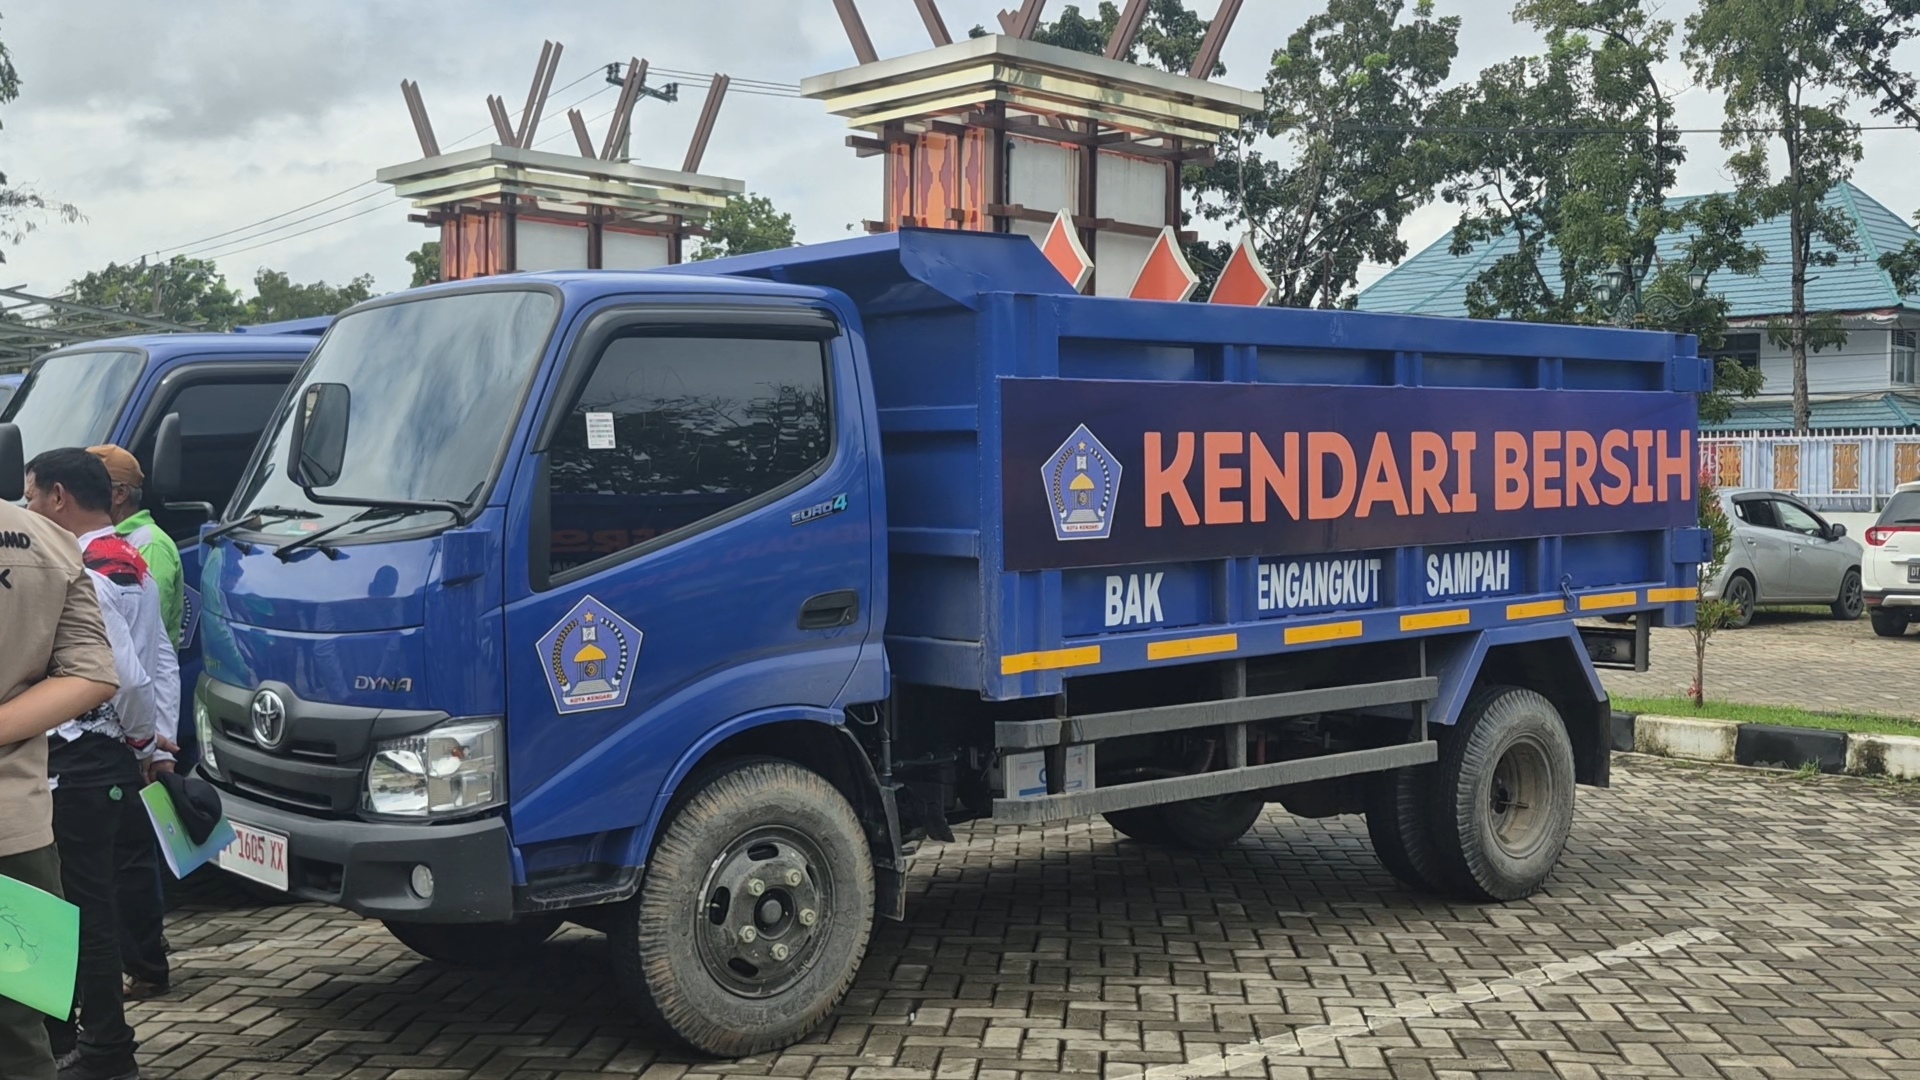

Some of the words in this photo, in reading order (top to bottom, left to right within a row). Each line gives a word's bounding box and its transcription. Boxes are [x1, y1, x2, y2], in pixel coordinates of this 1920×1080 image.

[1144, 431, 1477, 527] KENDARI
[1494, 428, 1691, 511] BERSIH
[1105, 572, 1164, 627] BAK
[1257, 558, 1381, 610] ENGANGKUT
[1426, 550, 1510, 597] SAMPAH
[354, 675, 412, 692] DYNA
[236, 829, 265, 865] 1605
[270, 840, 284, 872] XX
